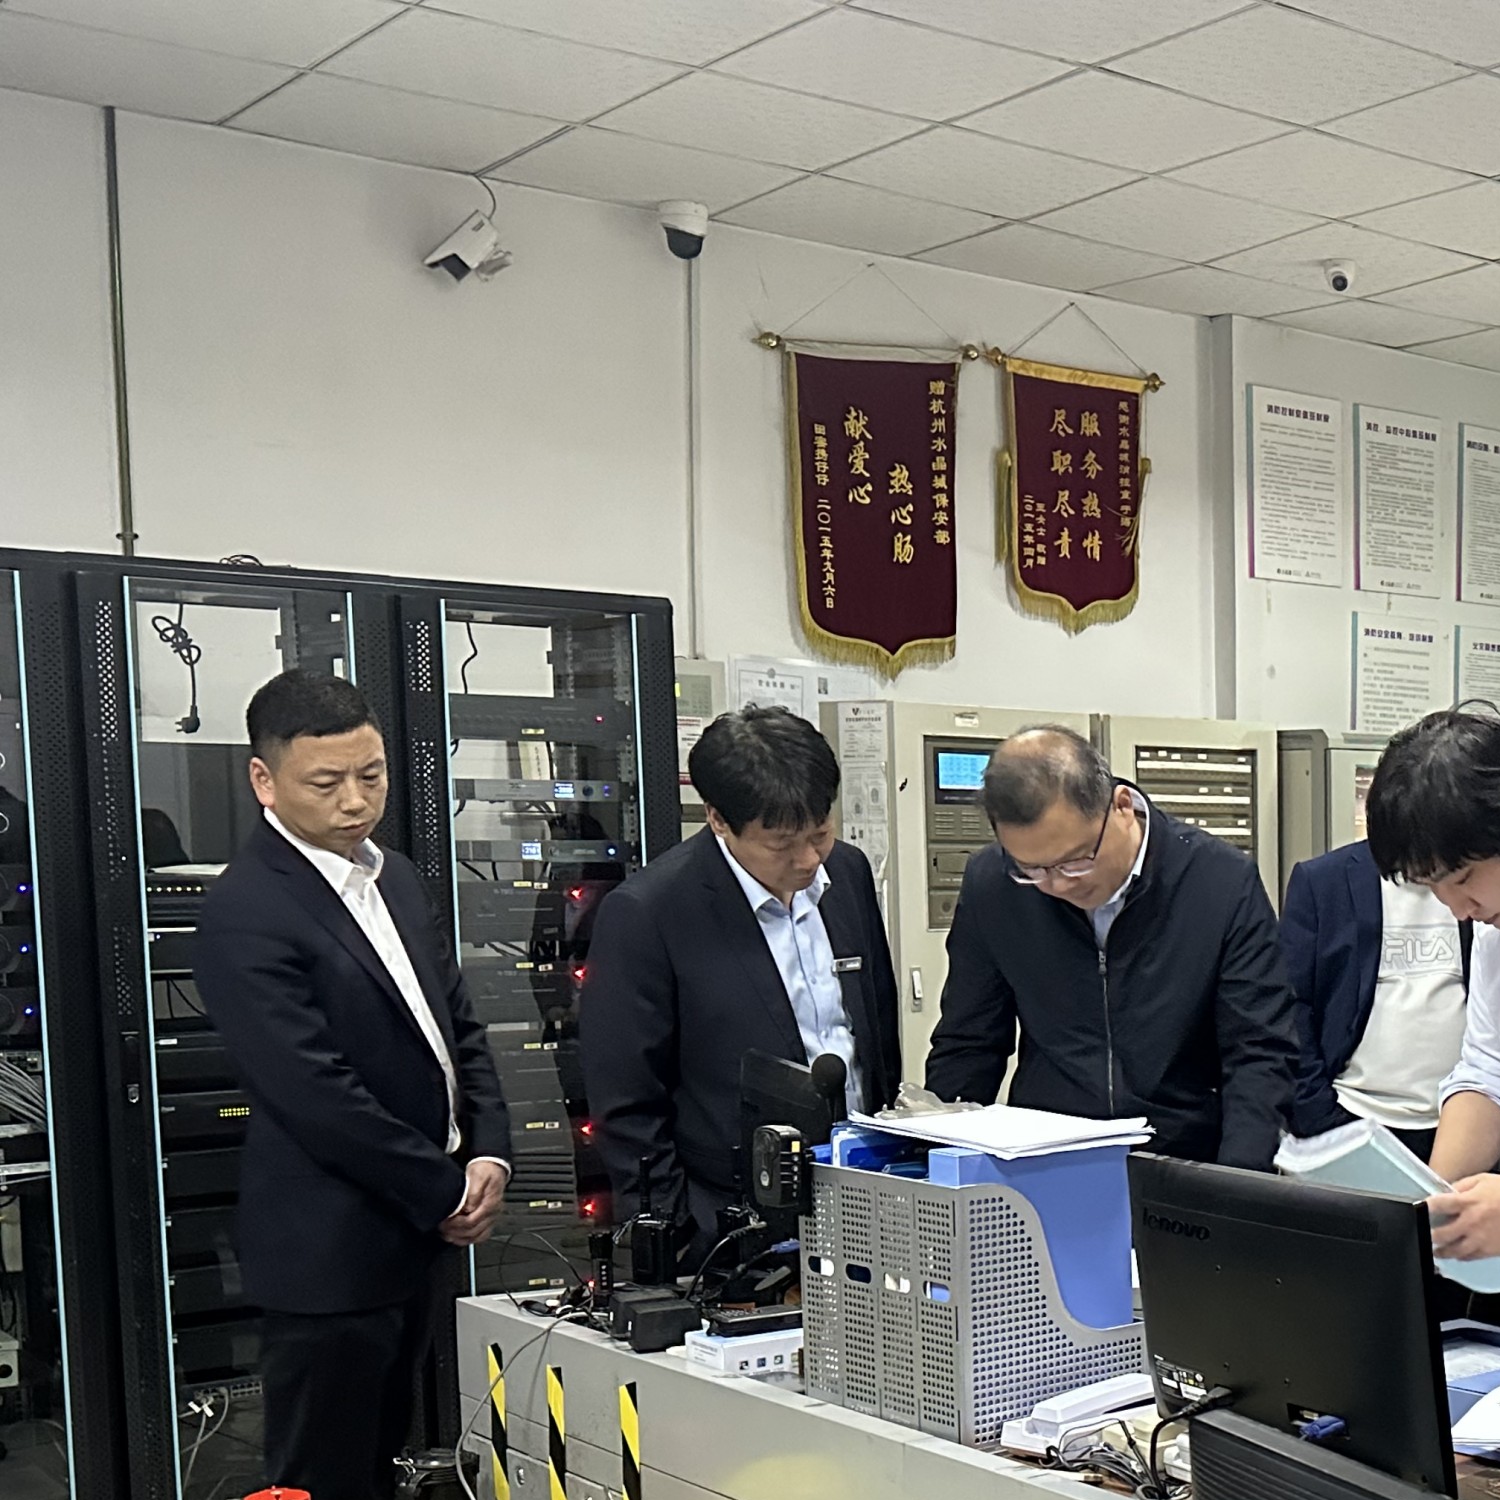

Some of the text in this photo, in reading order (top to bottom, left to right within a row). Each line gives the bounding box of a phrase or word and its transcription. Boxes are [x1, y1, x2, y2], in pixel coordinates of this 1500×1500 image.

[844, 406, 873, 505] 献爱心
[888, 464, 914, 564] 热心肠
[929, 380, 950, 545] 赠杭州水晶城保安部
[1049, 408, 1076, 559] 尽职尽责
[1079, 411, 1103, 562] 服务热情
[1142, 1207, 1211, 1242] lenovo
